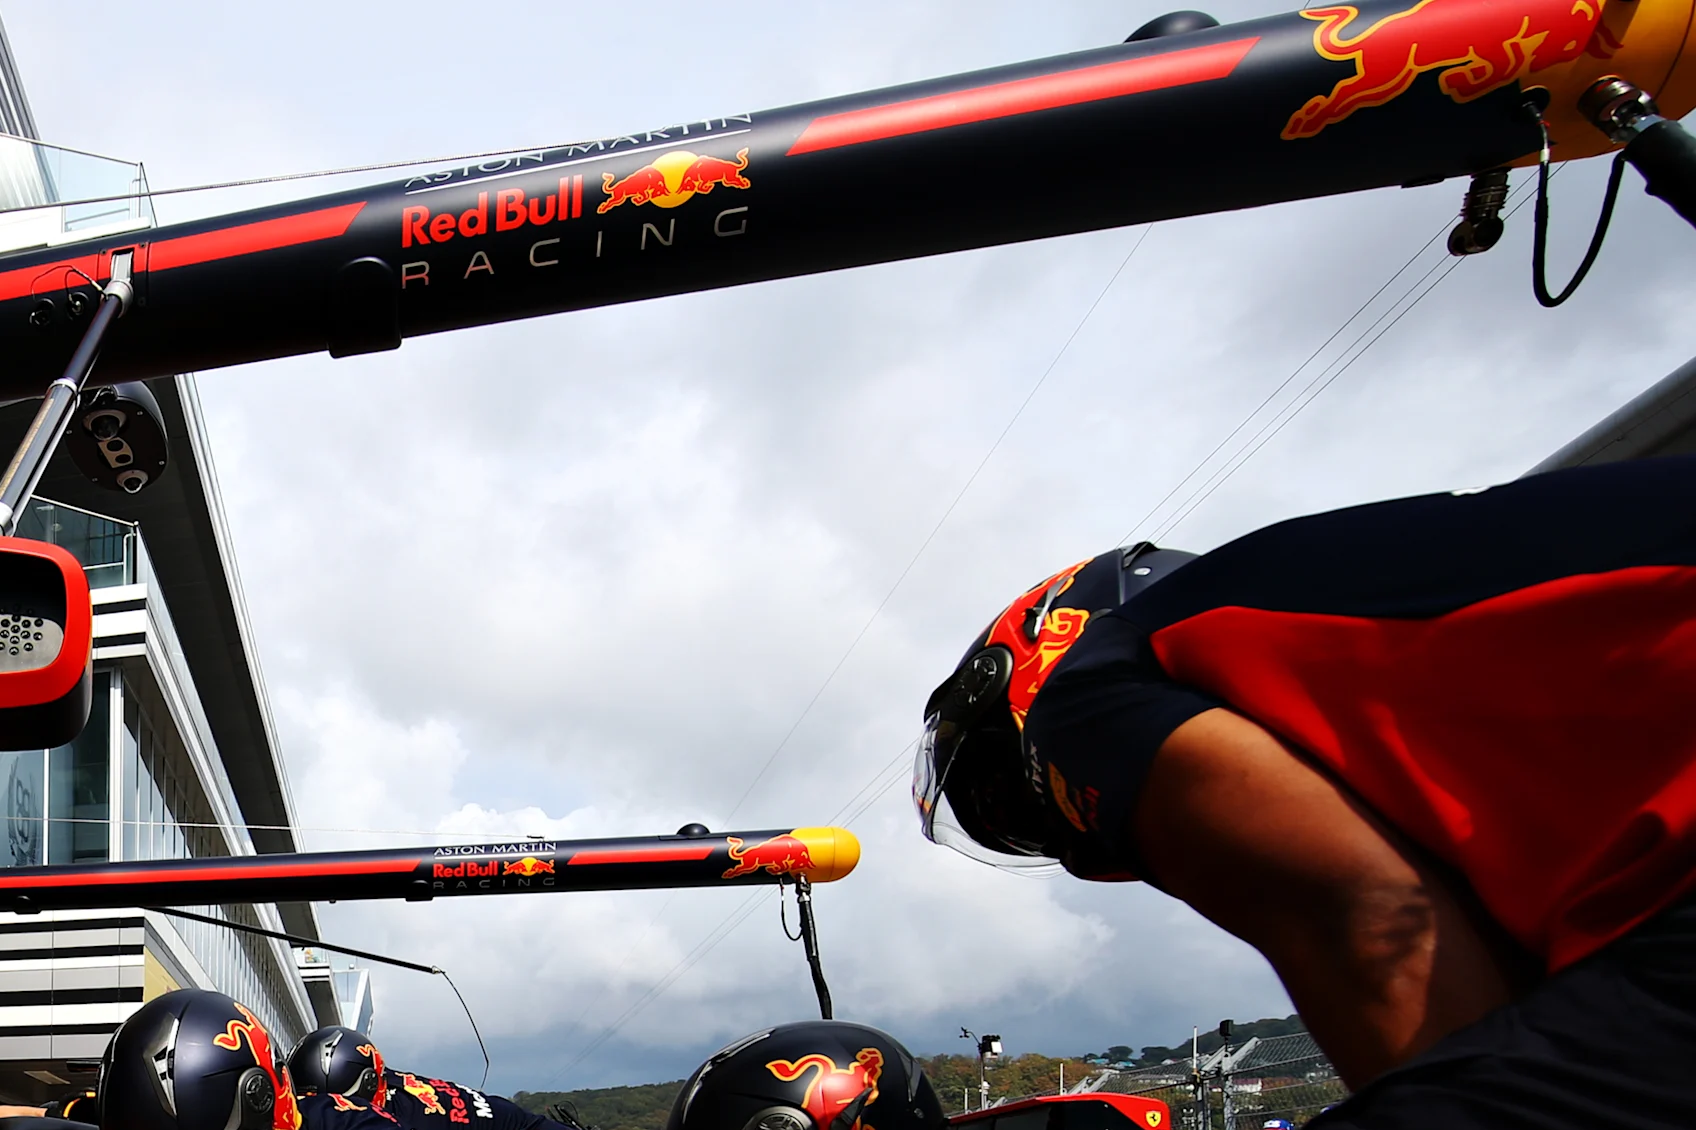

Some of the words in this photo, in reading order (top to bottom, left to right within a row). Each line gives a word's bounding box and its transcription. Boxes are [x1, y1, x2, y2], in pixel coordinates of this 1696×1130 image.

[405, 151, 544, 188] ASTON
[567, 112, 752, 157] MARTIN
[402, 191, 488, 248] Red
[496, 174, 583, 231] Bull
[402, 206, 749, 290] RACING
[432, 862, 465, 879] Red
[466, 860, 499, 877] Bull
[433, 846, 485, 857] ASTON
[491, 841, 558, 853] MARTIN
[432, 877, 556, 890] RACING
